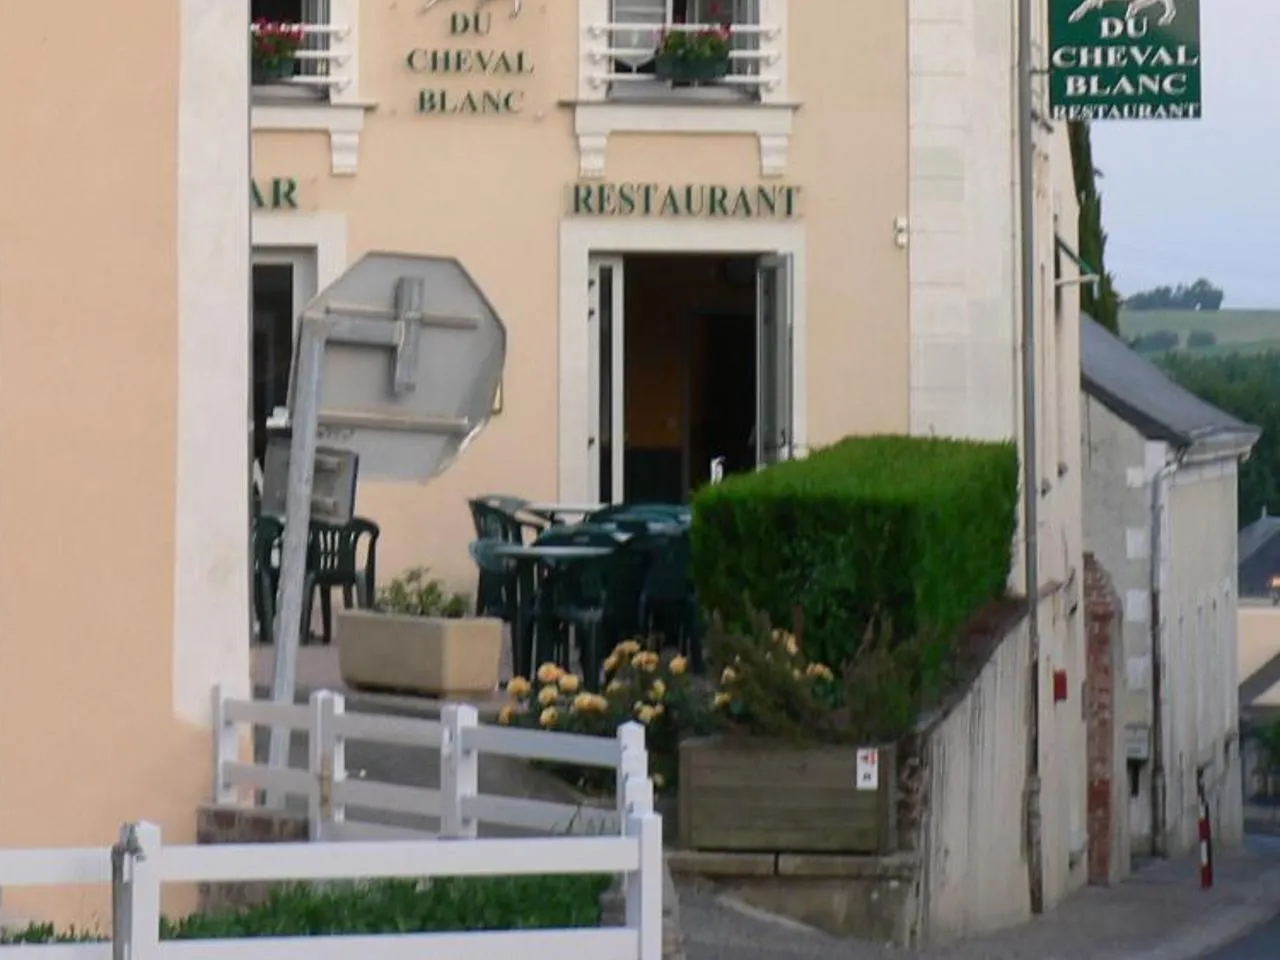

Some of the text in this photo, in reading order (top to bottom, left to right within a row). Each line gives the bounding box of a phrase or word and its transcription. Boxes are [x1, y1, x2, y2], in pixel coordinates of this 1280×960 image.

[450, 12, 491, 35] DU
[1100, 17, 1148, 38] DU
[405, 48, 535, 74] CHEVAL
[1052, 45, 1199, 68] CHEVAL
[1065, 73, 1188, 97] BLANC
[417, 89, 525, 114] BLANC
[1053, 102, 1200, 121] RESTAURANT
[250, 177, 298, 210] AR
[573, 183, 802, 218] RESTAURANT
